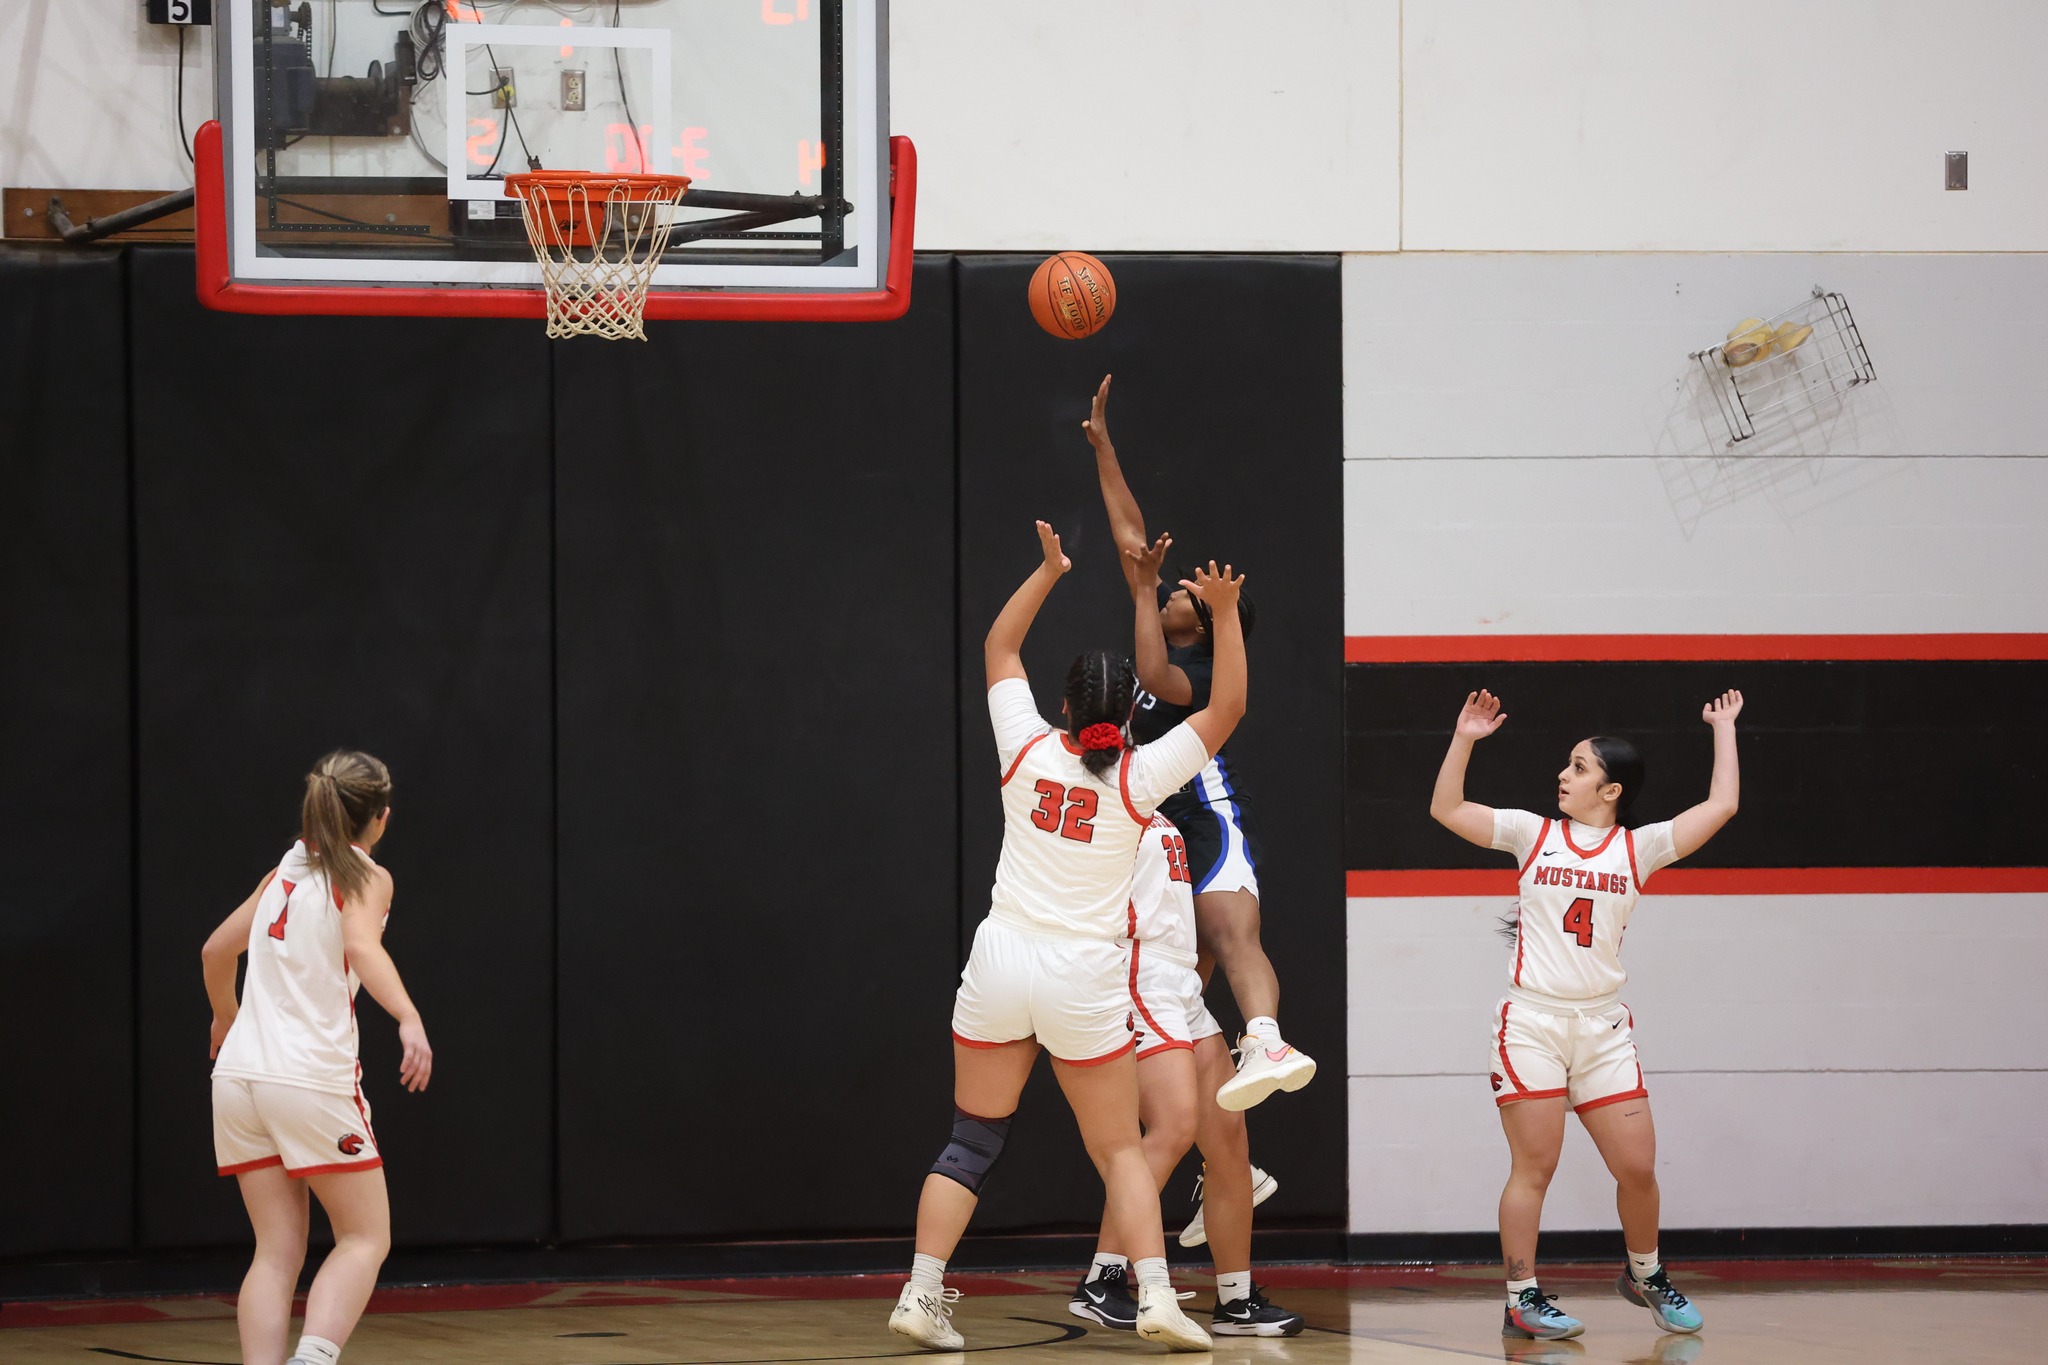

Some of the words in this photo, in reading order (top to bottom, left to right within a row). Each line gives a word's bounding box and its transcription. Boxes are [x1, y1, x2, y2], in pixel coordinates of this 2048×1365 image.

[172, 0, 189, 21] 5
[1076, 267, 1106, 325] SPALDING
[1031, 779, 1099, 843] 32
[1161, 835, 1192, 884] 22
[1534, 866, 1627, 895] MUSTANGS
[1563, 897, 1594, 947] 4
